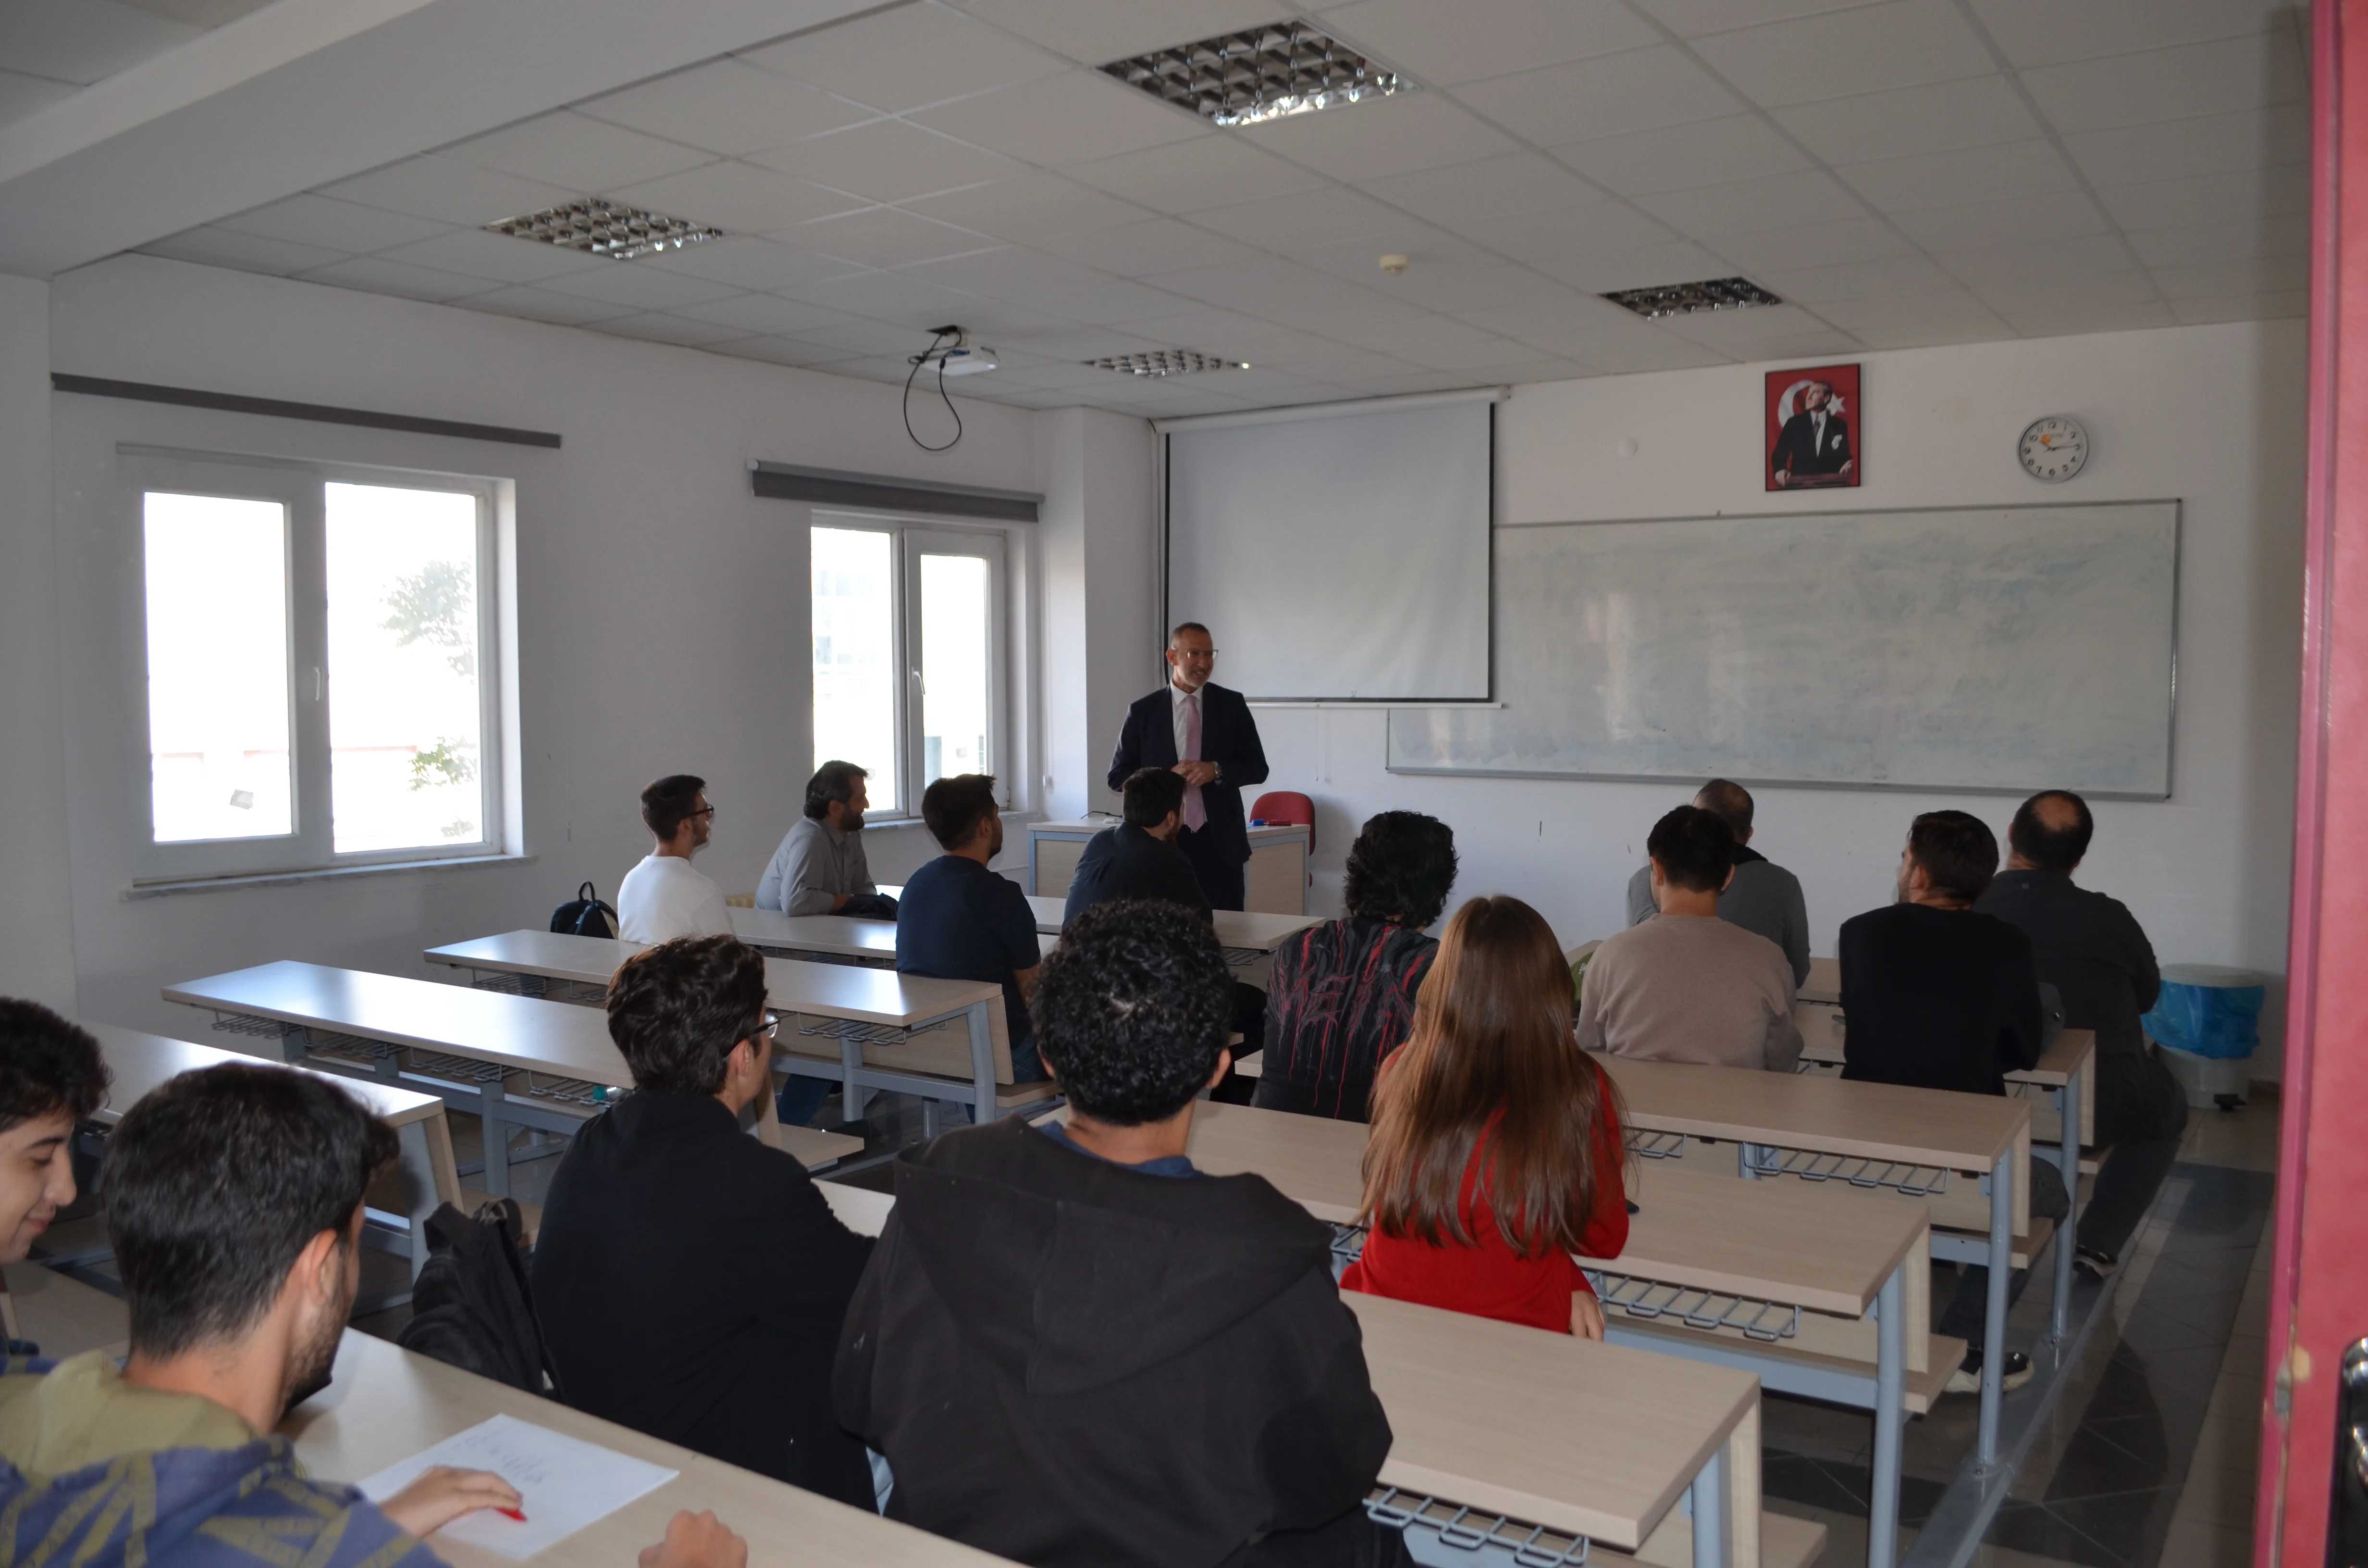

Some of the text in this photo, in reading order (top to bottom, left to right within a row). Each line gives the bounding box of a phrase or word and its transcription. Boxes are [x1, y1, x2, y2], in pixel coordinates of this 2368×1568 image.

[2064, 421, 2068, 432] 1
[2036, 466, 2042, 475] 7
[2048, 467, 2056, 476] 6
